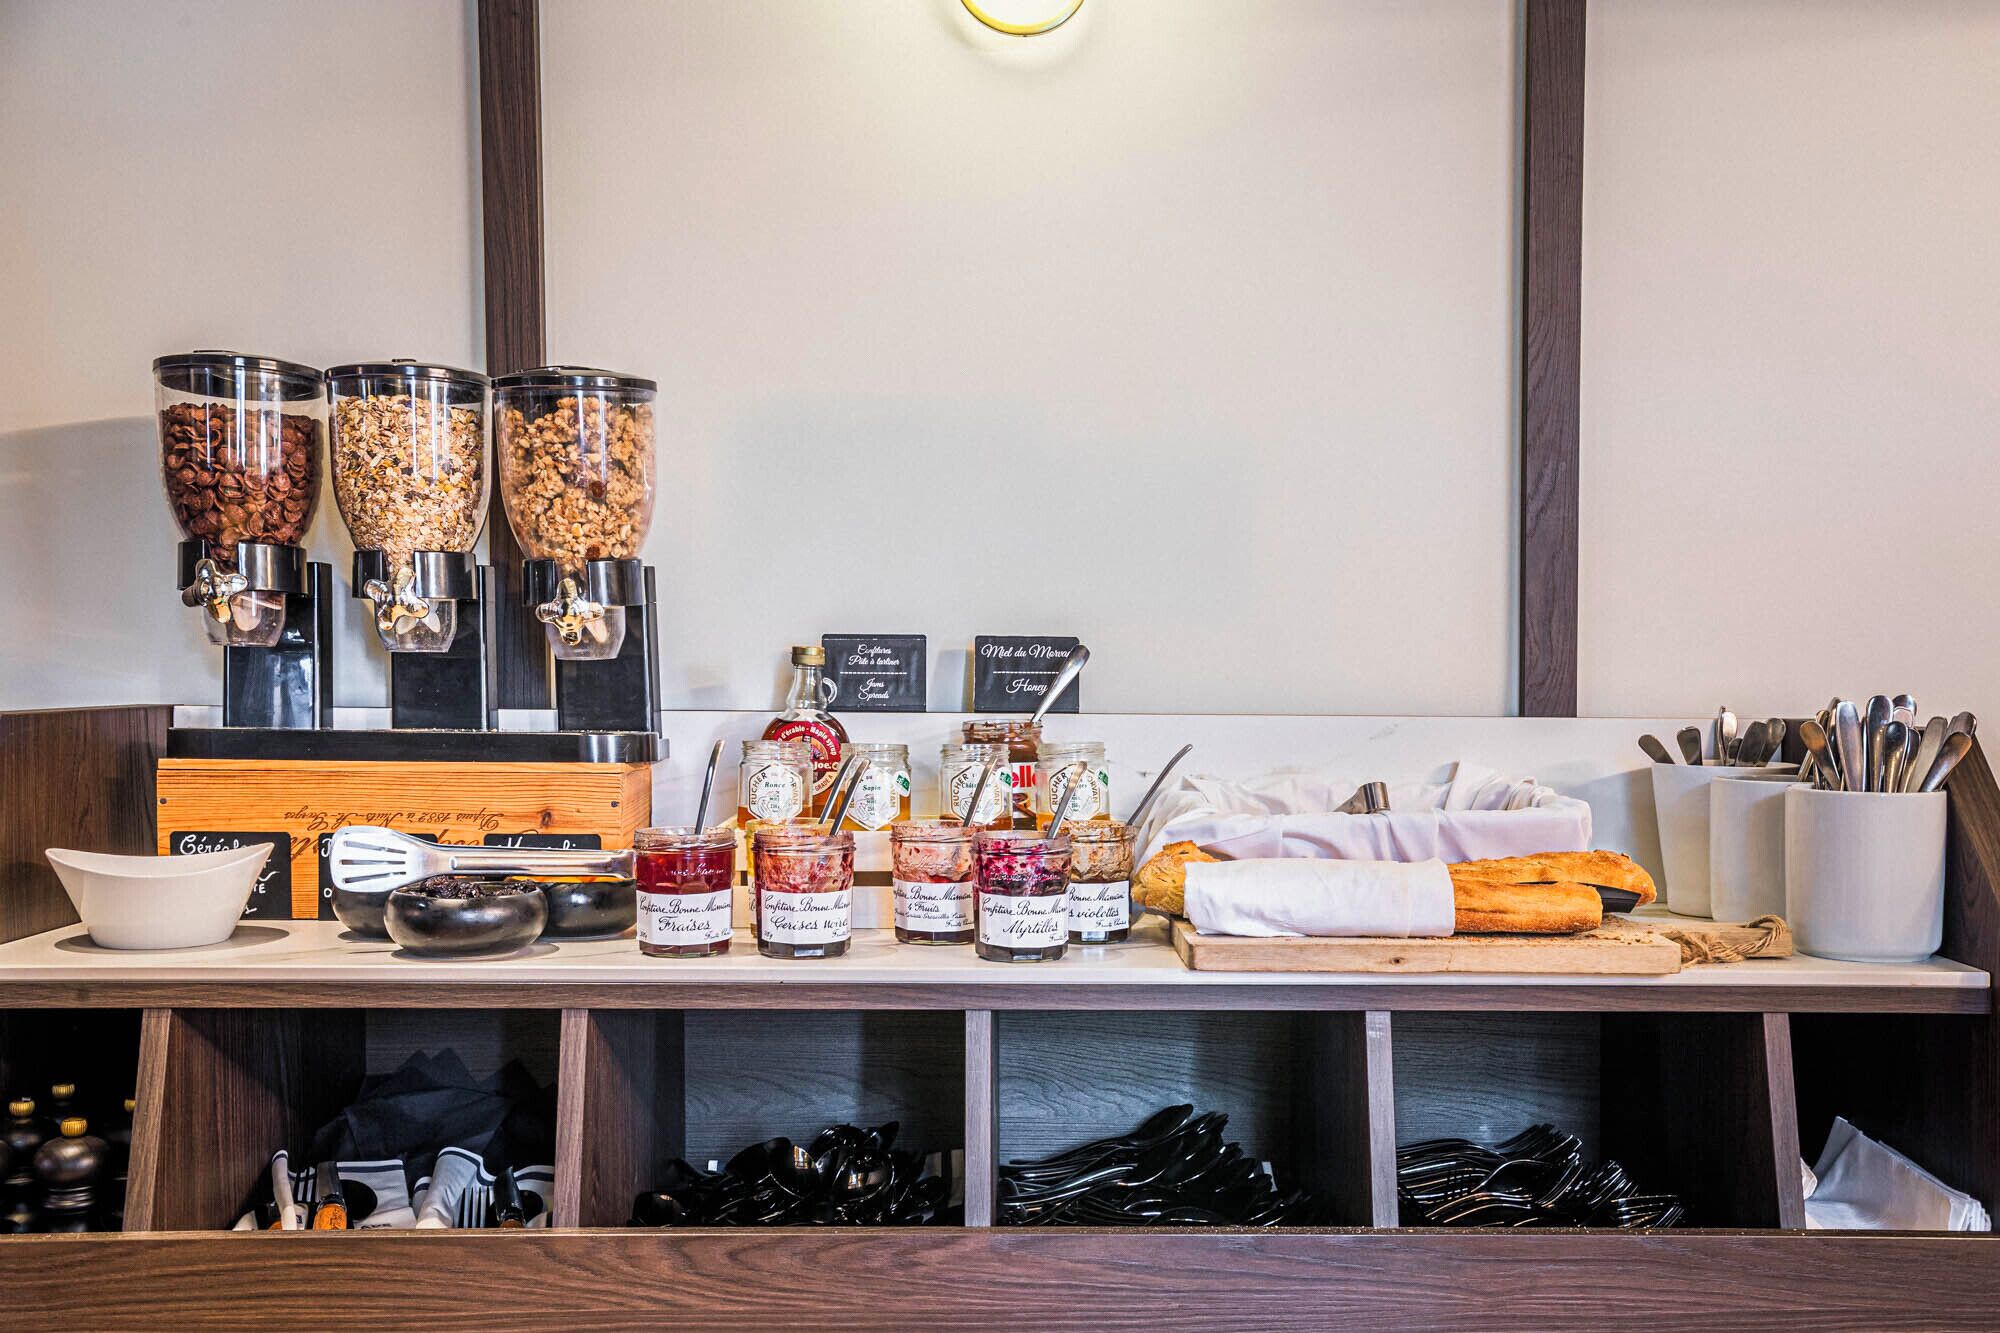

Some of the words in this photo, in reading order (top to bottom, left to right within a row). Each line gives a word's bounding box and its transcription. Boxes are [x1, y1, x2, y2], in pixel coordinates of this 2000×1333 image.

[857, 644, 892, 657] Confitures
[980, 643, 1013, 659] Miel
[1014, 647, 1027, 657] du
[848, 655, 869, 665] Pâte
[860, 677, 885, 691] Jams
[1005, 678, 1048, 696] Honey
[858, 689, 890, 701] Spreads
[825, 737, 838, 756] syrup
[750, 771, 768, 806] RUCHER
[952, 773, 969, 807] RUCHER
[1051, 771, 1067, 806] RUCHER
[417, 812, 453, 823] 1882
[456, 807, 505, 831] Depuis
[910, 885, 939, 901] Bonne
[940, 886, 973, 901] Maman
[1093, 887, 1125, 901] Maman
[669, 898, 701, 914] Bonne
[701, 896, 733, 912] Maman
[764, 894, 799, 914] Confiture
[799, 896, 830, 912] Bonne
[914, 901, 940, 913] Fruits
[981, 896, 1016, 916] Confiture
[1016, 899, 1048, 916] Bonne
[1076, 905, 1119, 918] violettes
[658, 915, 711, 932] Fraises
[770, 915, 818, 931] Cerises
[1002, 917, 1058, 940] Myrtilles
